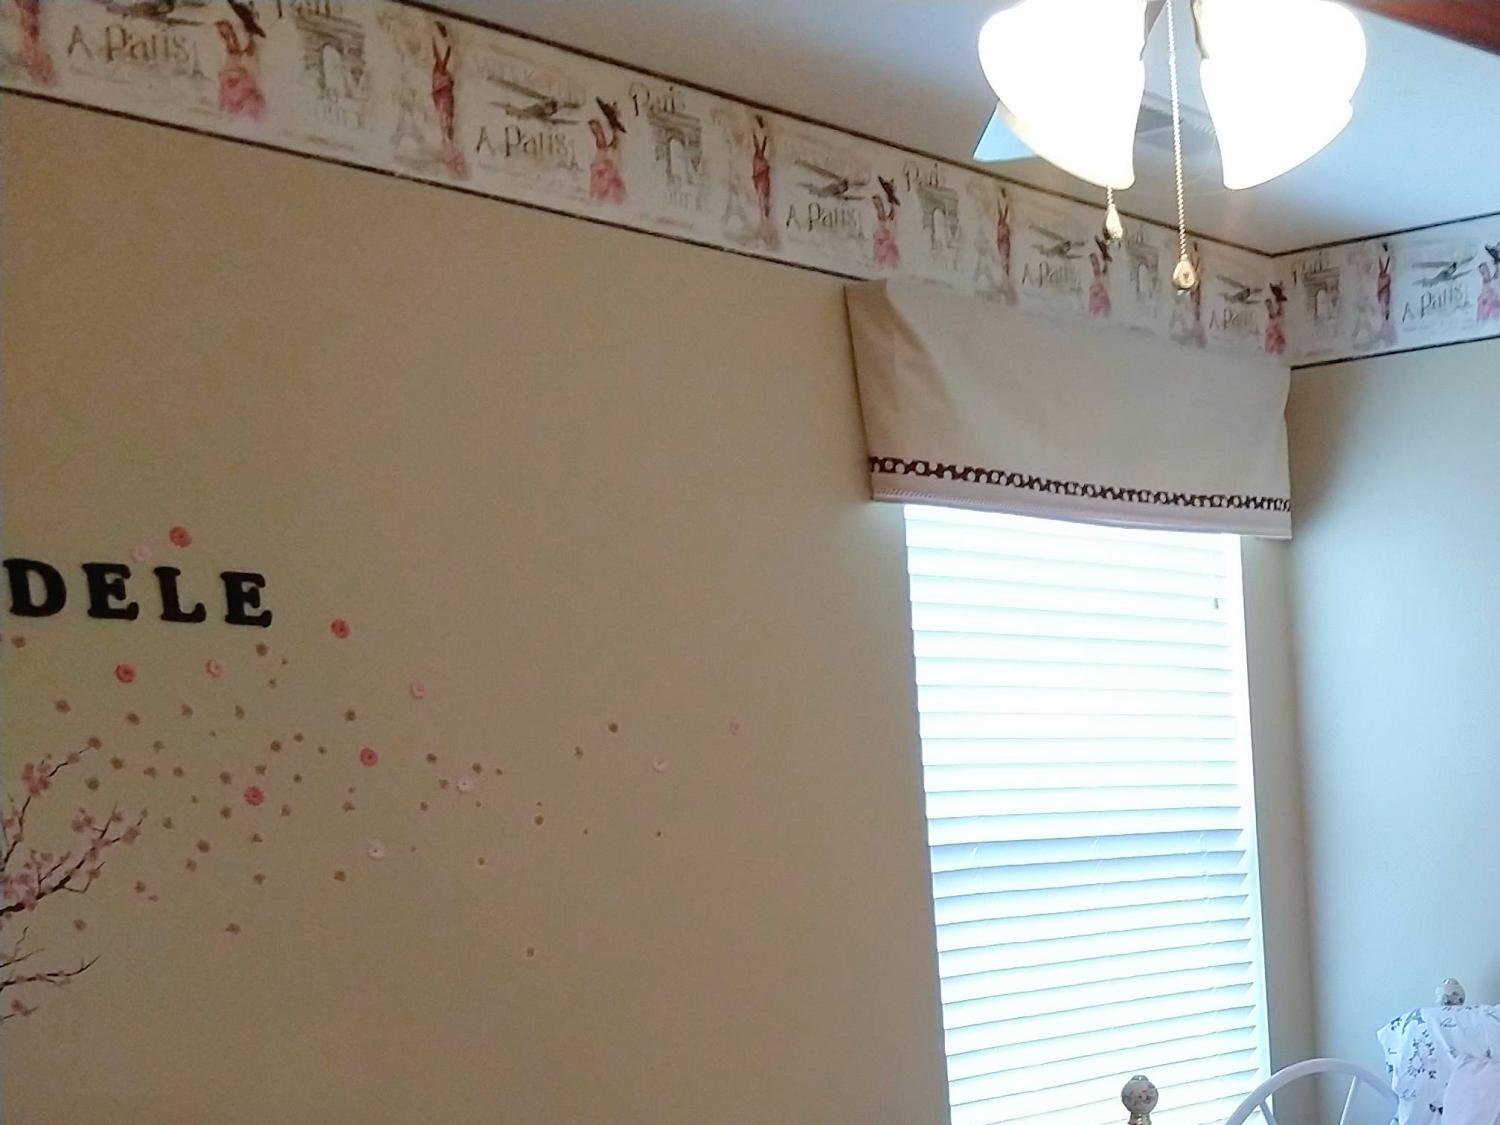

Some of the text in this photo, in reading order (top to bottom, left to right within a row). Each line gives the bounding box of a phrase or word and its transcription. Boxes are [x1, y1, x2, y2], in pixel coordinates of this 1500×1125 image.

[67, 24, 94, 58] A
[476, 126, 496, 154] A
[786, 204, 799, 227] A
[3, 558, 272, 628] DELE
